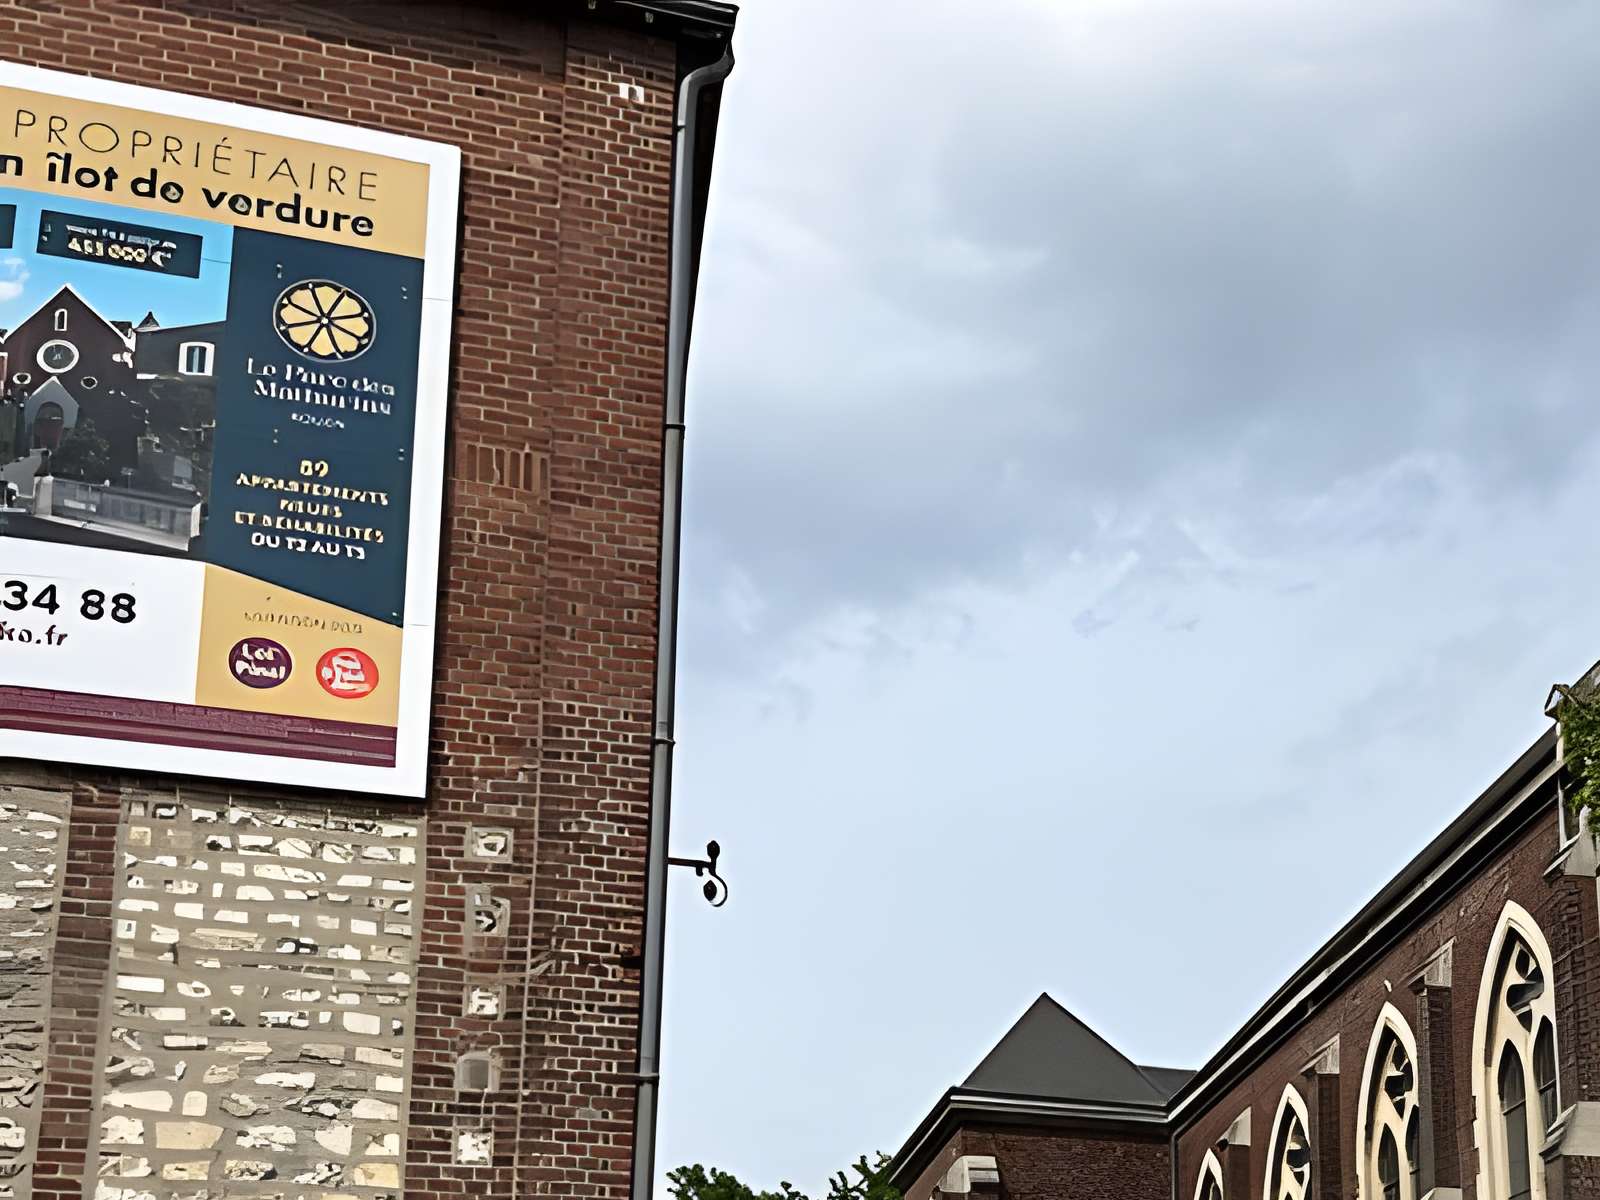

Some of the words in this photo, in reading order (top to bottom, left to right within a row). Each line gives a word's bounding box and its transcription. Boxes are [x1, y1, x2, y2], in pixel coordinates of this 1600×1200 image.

[15, 109, 378, 202] PROPRIÉTAIRE
[201, 187, 374, 237] verdure
[2, 579, 61, 616] 34
[79, 588, 137, 624] 88
